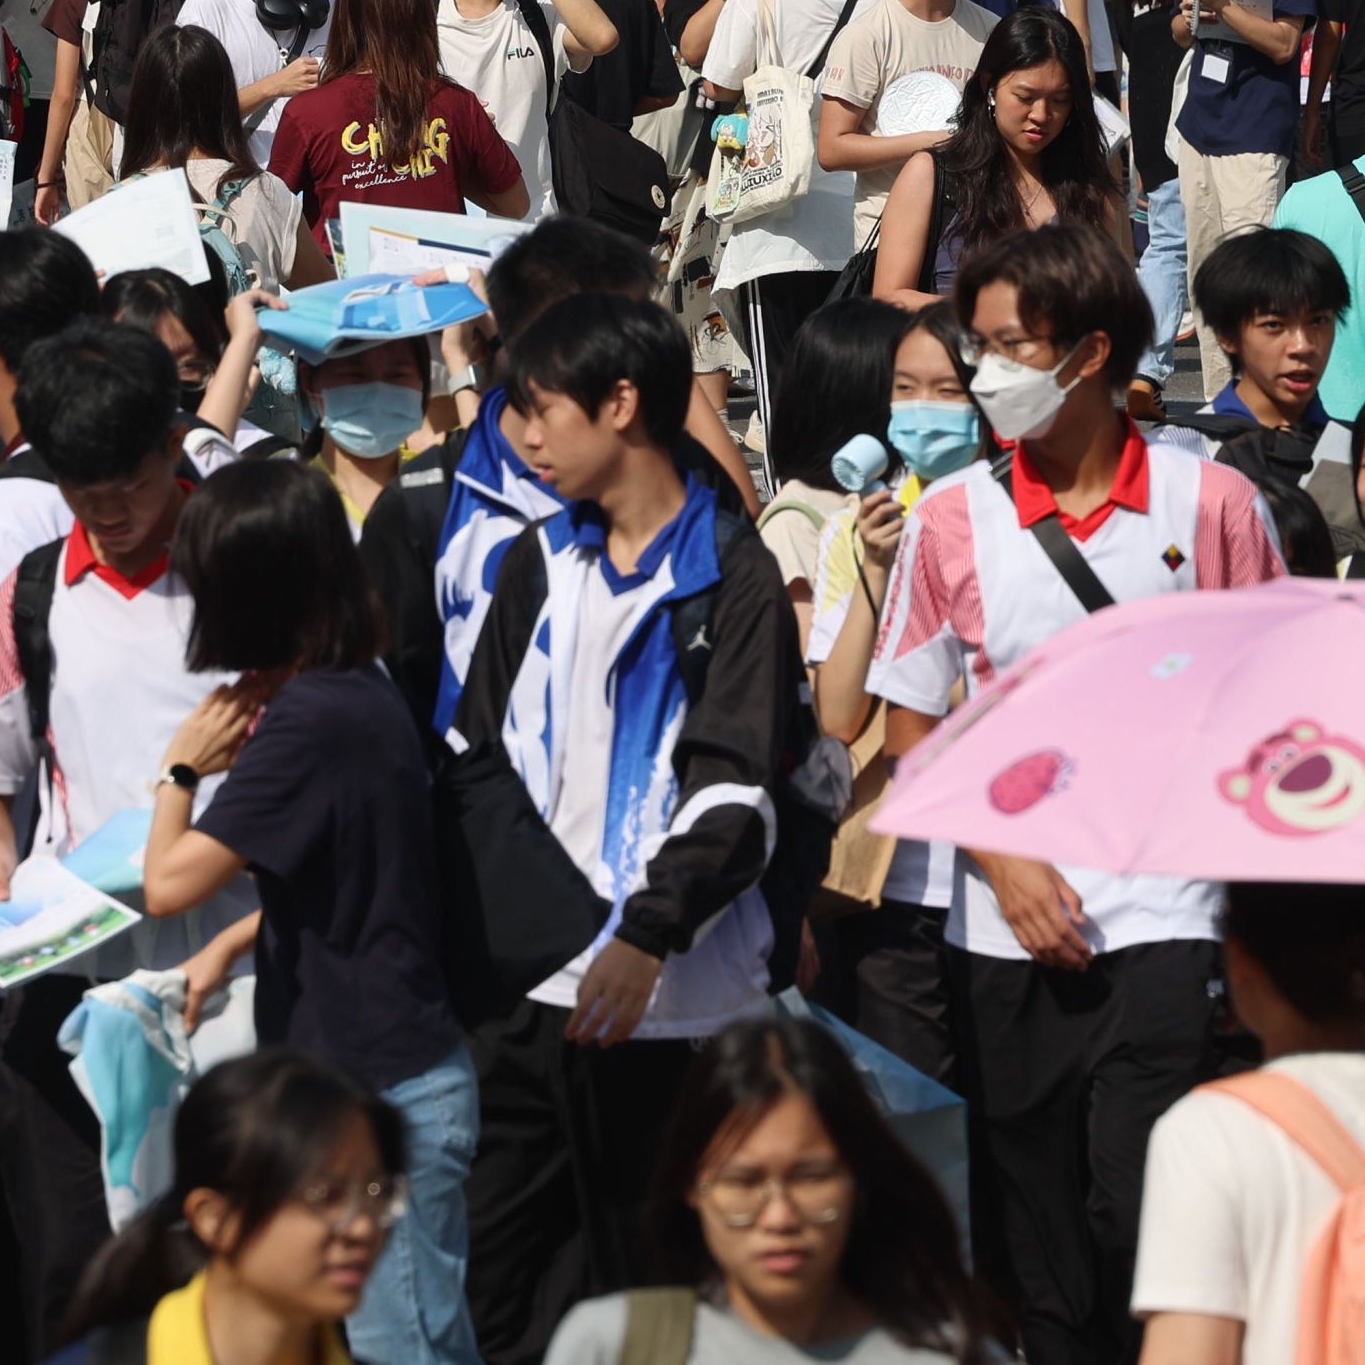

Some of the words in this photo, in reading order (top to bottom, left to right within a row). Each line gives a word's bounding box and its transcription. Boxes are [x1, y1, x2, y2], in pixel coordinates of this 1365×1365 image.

[507, 46, 535, 60] FILA
[351, 160, 365, 170] in
[342, 162, 376, 185] pursuit
[354, 175, 408, 190] excellence
